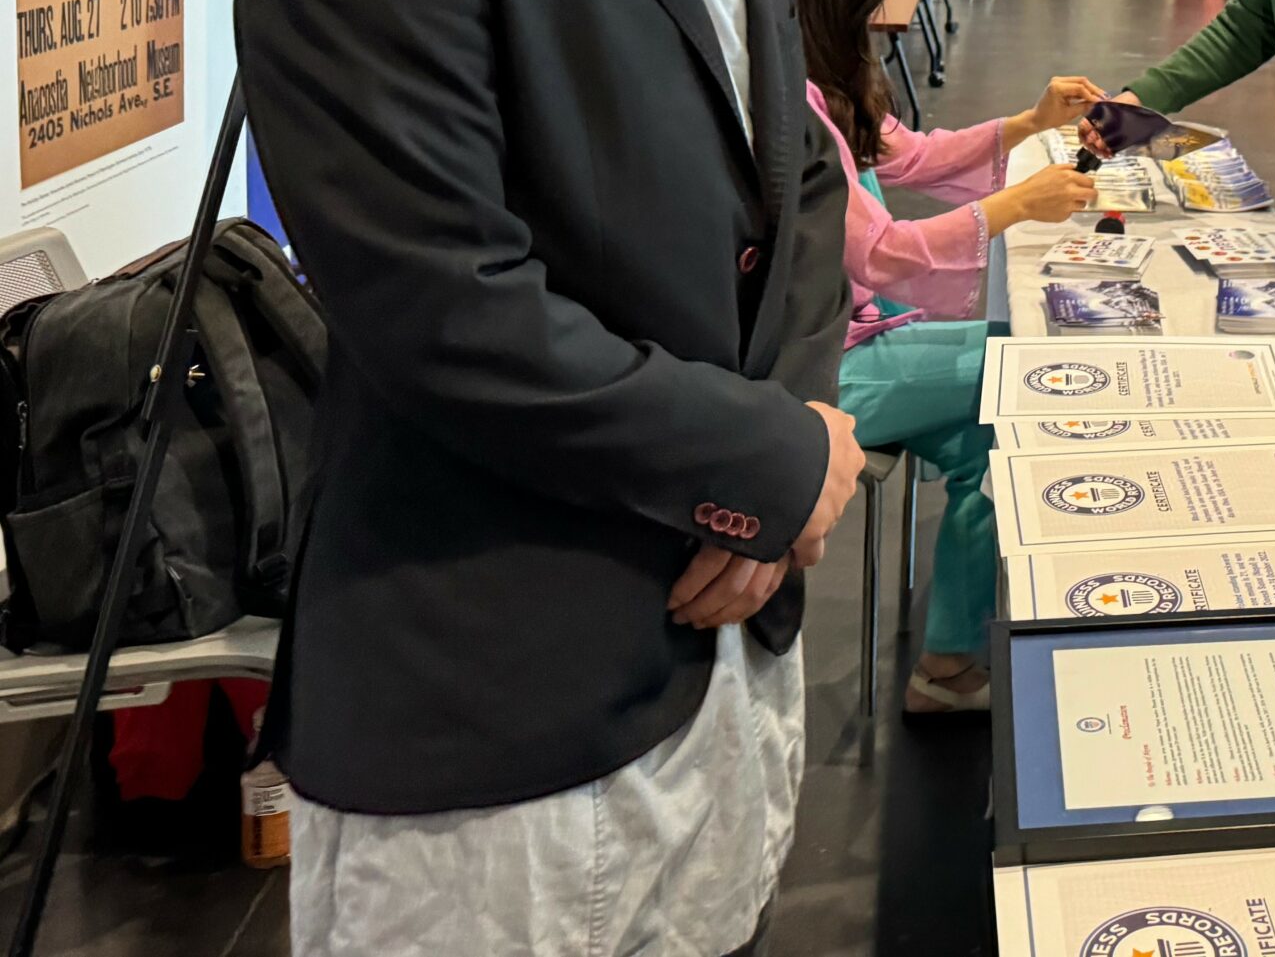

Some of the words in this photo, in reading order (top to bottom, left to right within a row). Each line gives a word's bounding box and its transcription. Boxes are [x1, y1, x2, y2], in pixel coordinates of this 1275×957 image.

[17, 3, 56, 61] THURS.
[19, 66, 68, 130] Anacostia
[78, 45, 137, 108] Neighborhood
[146, 32, 180, 83] Museum
[28, 116, 63, 152] 2405
[70, 97, 112, 135] Nichols
[153, 75, 173, 103] S.E.
[1061, 363, 1107, 384] RECORDS
[1062, 382, 1103, 395] WORLD
[1116, 361, 1129, 396] CERTIFICATE
[1048, 480, 1078, 512] GUINNESS
[1083, 476, 1140, 496] RECORDS
[1146, 471, 1170, 512] CERTIFICATE
[1091, 496, 1137, 514] WORLD
[1073, 580, 1104, 617] UINNESS
[1112, 575, 1176, 600] RECORDS
[1184, 568, 1208, 612] RTIFICATE
[1145, 912, 1238, 957] RECORDS
